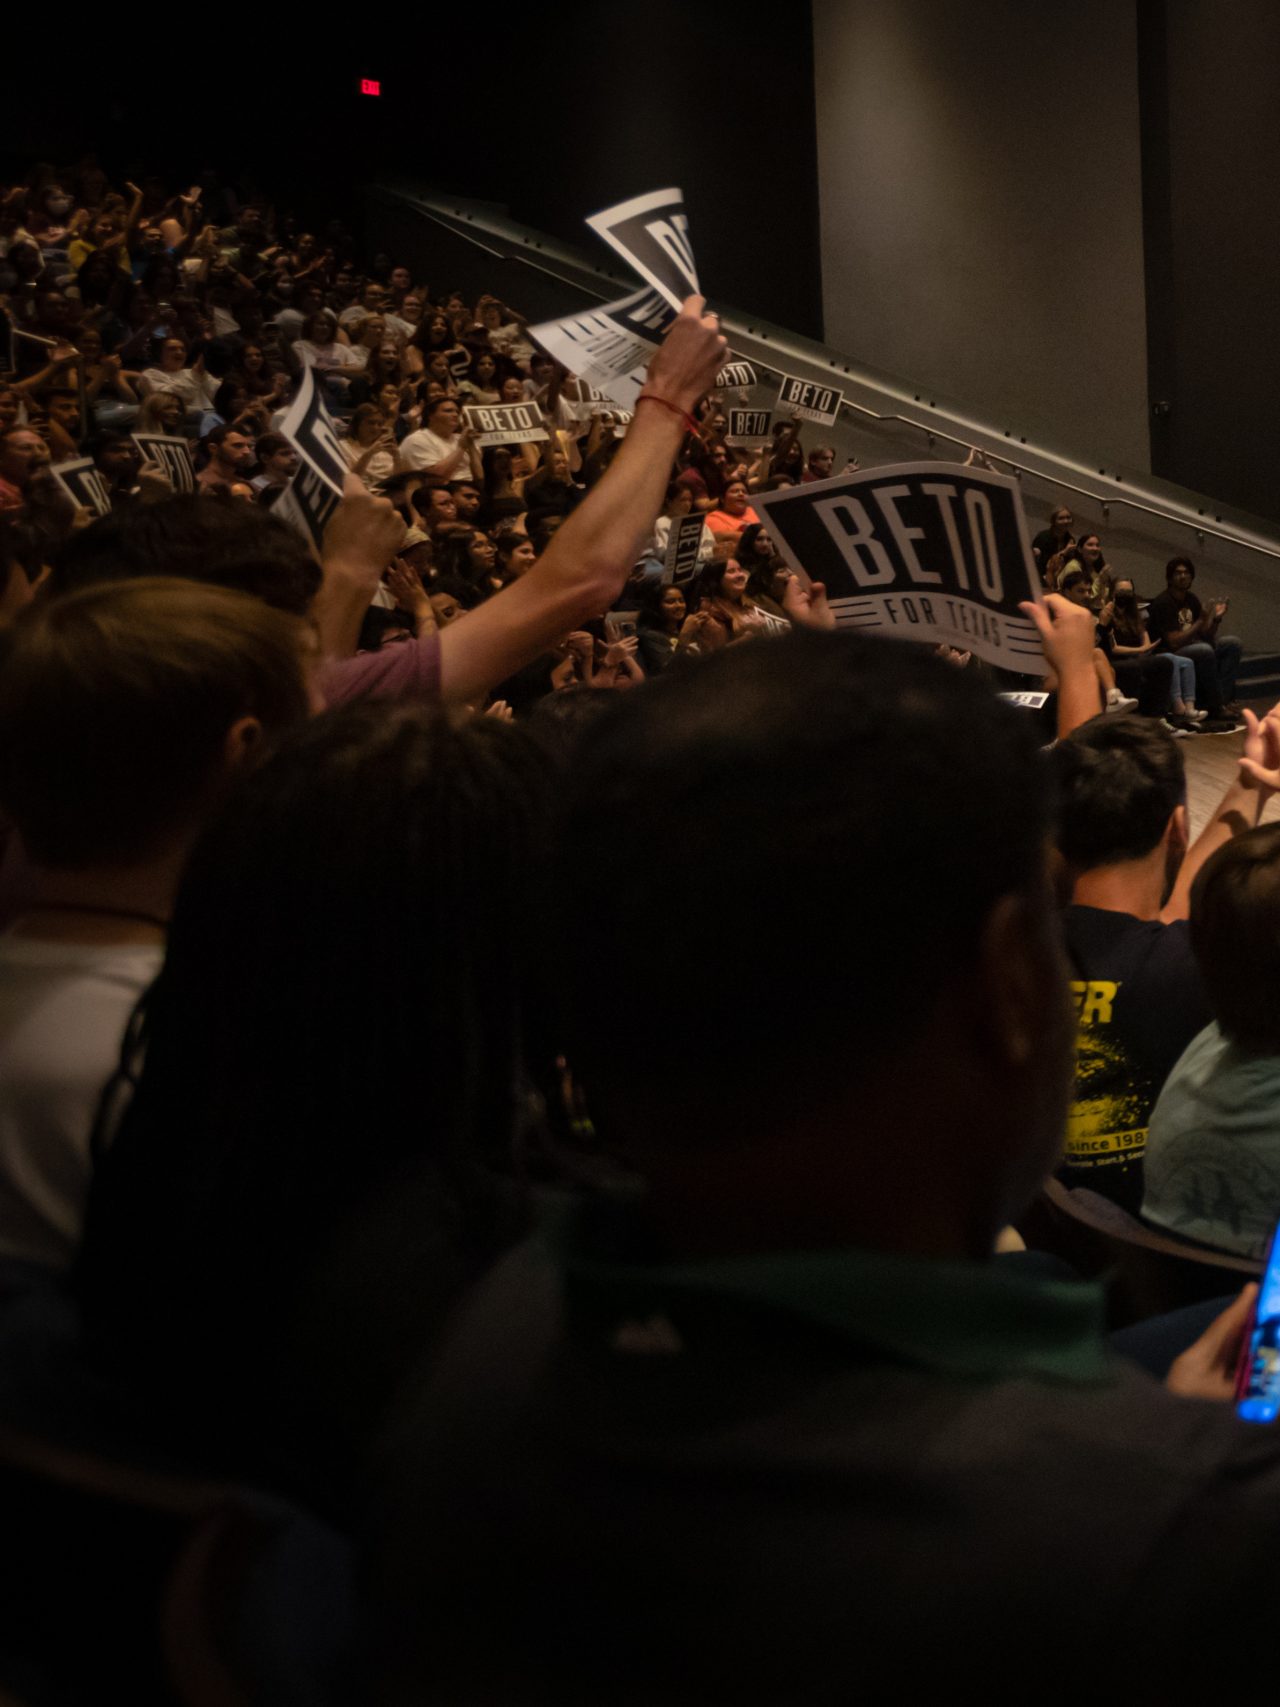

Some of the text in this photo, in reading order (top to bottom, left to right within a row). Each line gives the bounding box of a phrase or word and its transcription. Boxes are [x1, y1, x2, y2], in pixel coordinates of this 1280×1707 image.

[788, 380, 833, 411] BETO
[477, 407, 533, 431] BETO
[736, 412, 767, 435] BETO
[675, 522, 702, 574] BETO
[811, 482, 1005, 603] BETO
[883, 597, 1001, 647] FOR TEXAS
[1114, 1130, 1149, 1148] 198
